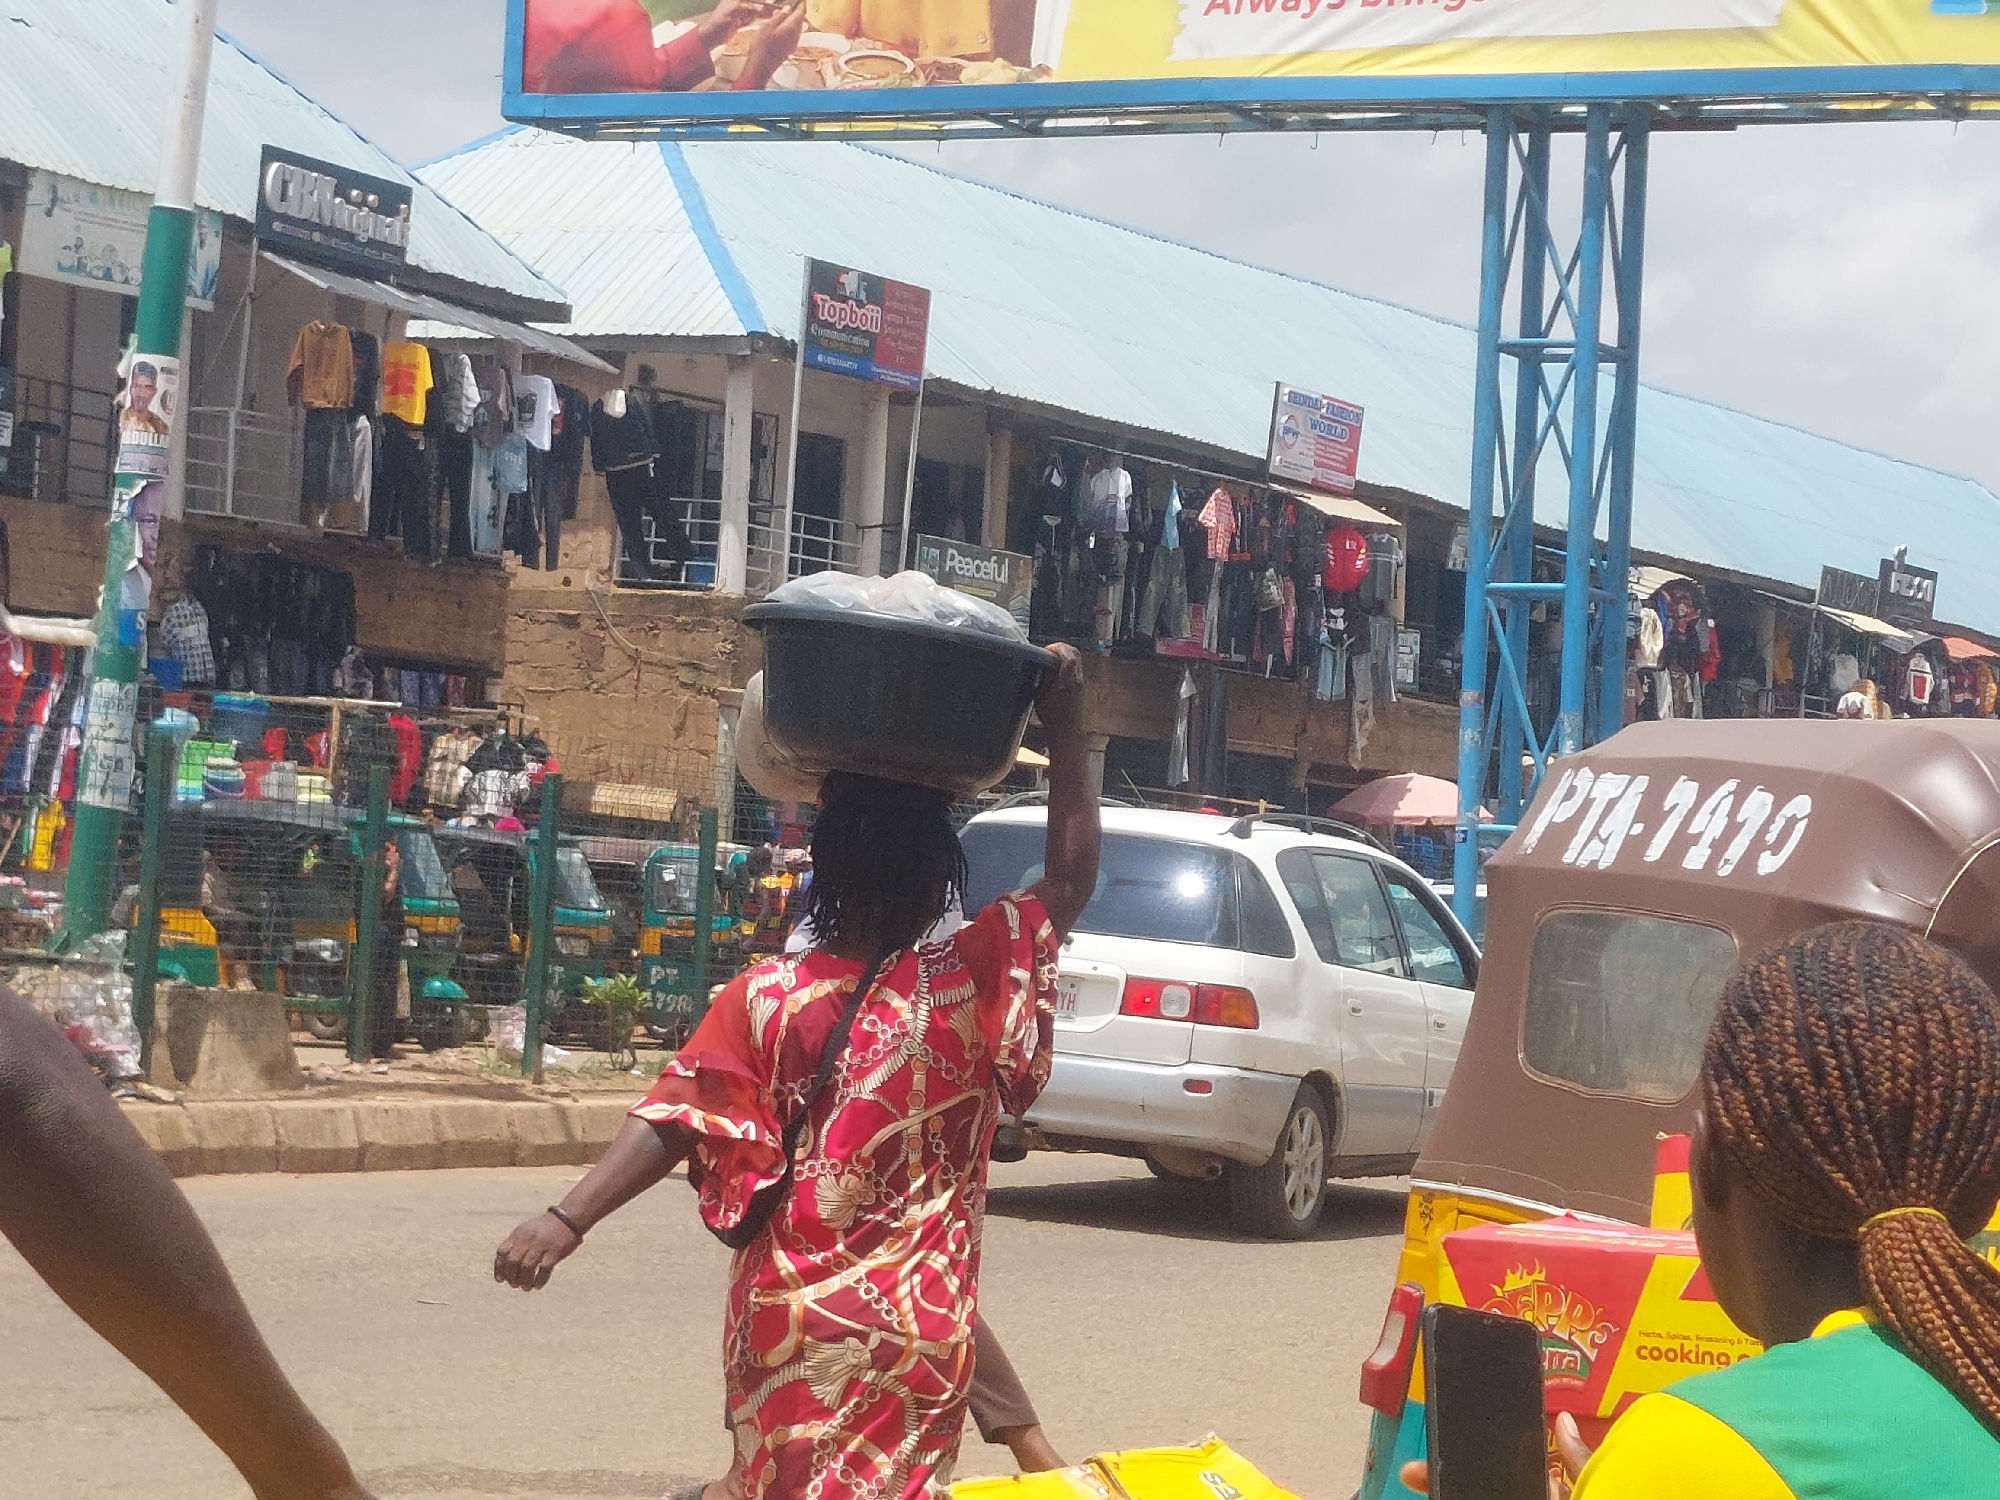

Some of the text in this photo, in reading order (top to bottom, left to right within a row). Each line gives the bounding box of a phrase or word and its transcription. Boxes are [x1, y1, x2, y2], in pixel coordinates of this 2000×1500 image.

[1309, 417, 1348, 440] WORLD
[945, 548, 1009, 583] Peaceful
[1635, 1342, 1731, 1370] cooking
